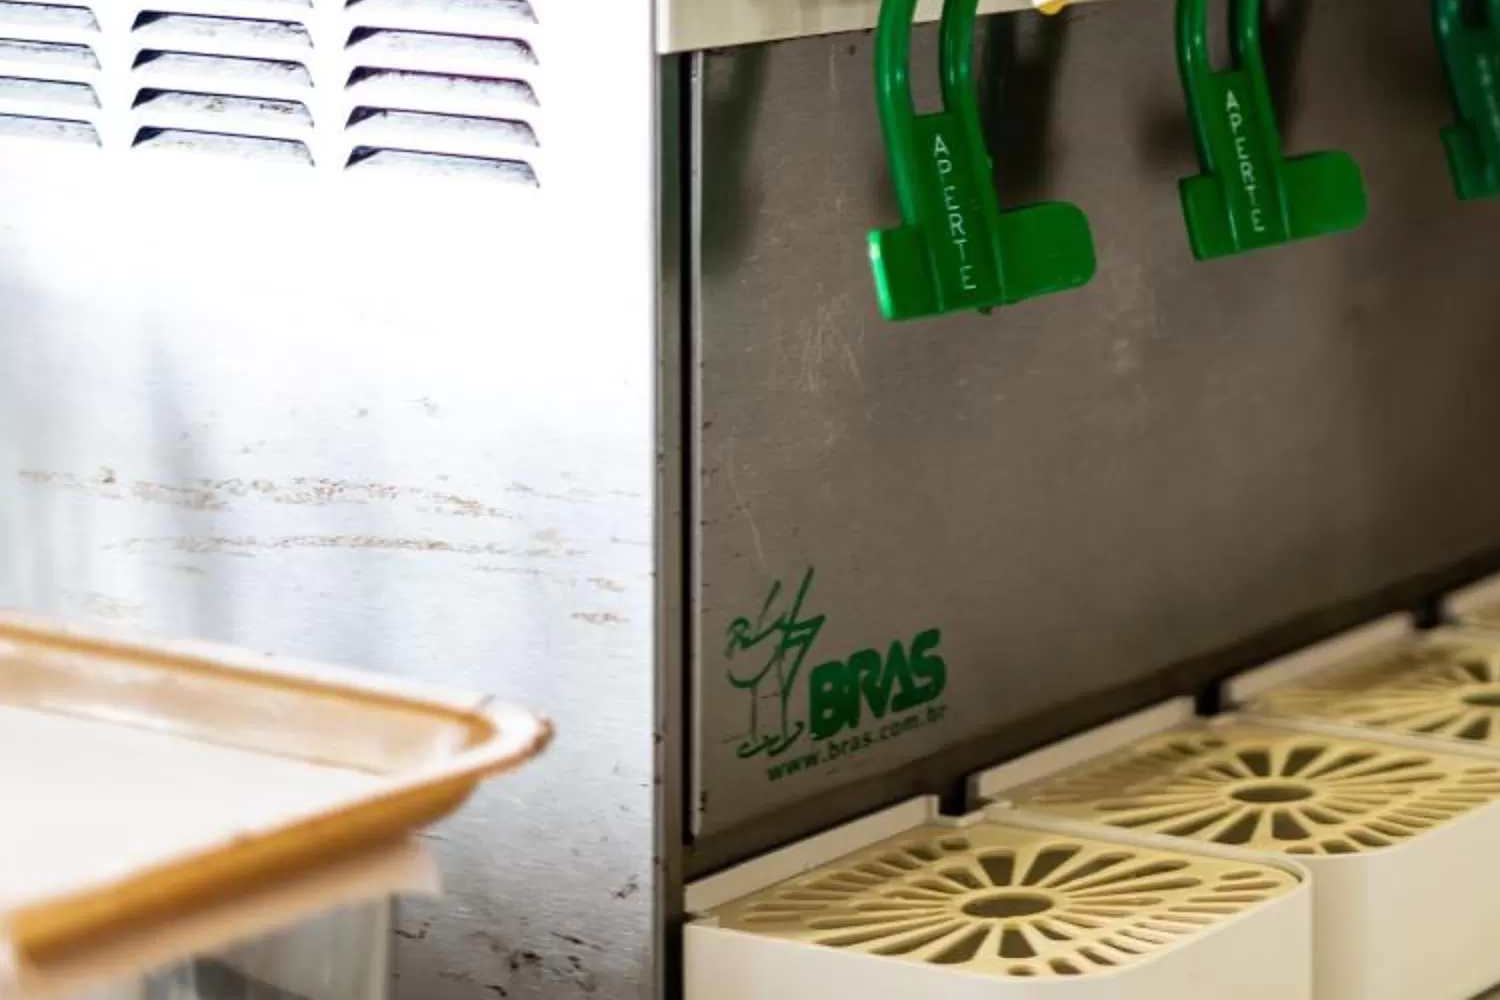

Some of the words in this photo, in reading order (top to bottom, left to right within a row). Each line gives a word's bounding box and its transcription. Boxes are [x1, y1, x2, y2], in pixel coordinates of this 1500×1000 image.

[933, 134, 976, 291] APERTE
[1226, 90, 1265, 232] APERTE
[767, 704, 947, 781] www.bras.com.br
[810, 628, 946, 740] BRAS
